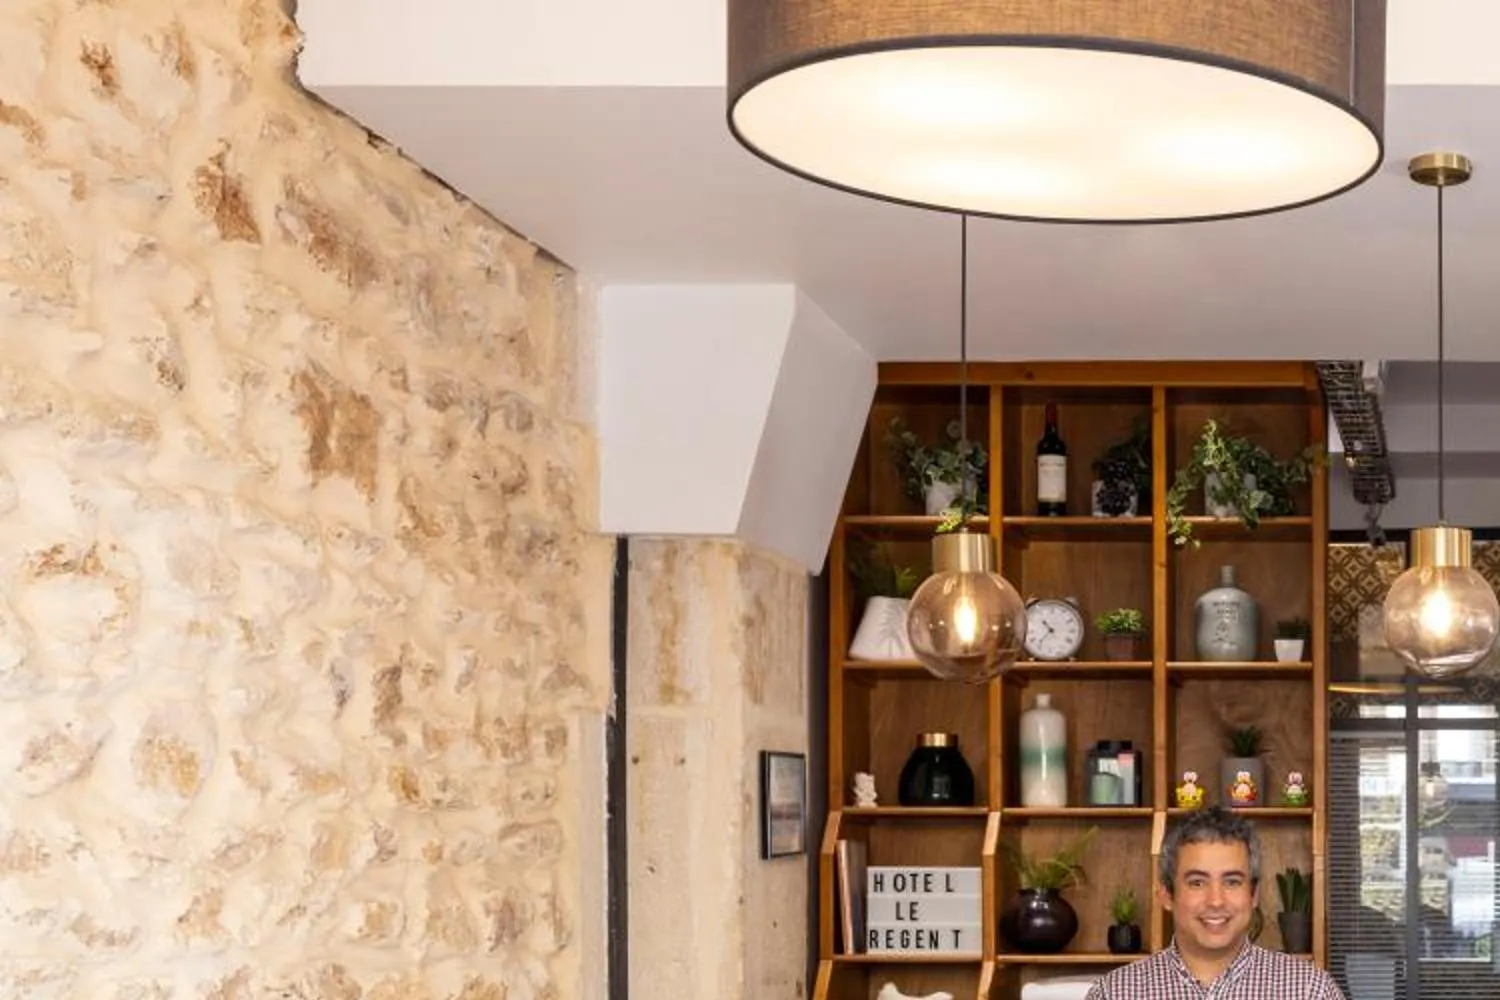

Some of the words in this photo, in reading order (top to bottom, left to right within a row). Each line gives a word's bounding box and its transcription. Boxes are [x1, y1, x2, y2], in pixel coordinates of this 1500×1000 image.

[873, 873, 954, 893] HOTEL
[895, 901, 919, 921] LE
[869, 929, 961, 949] REGENT
